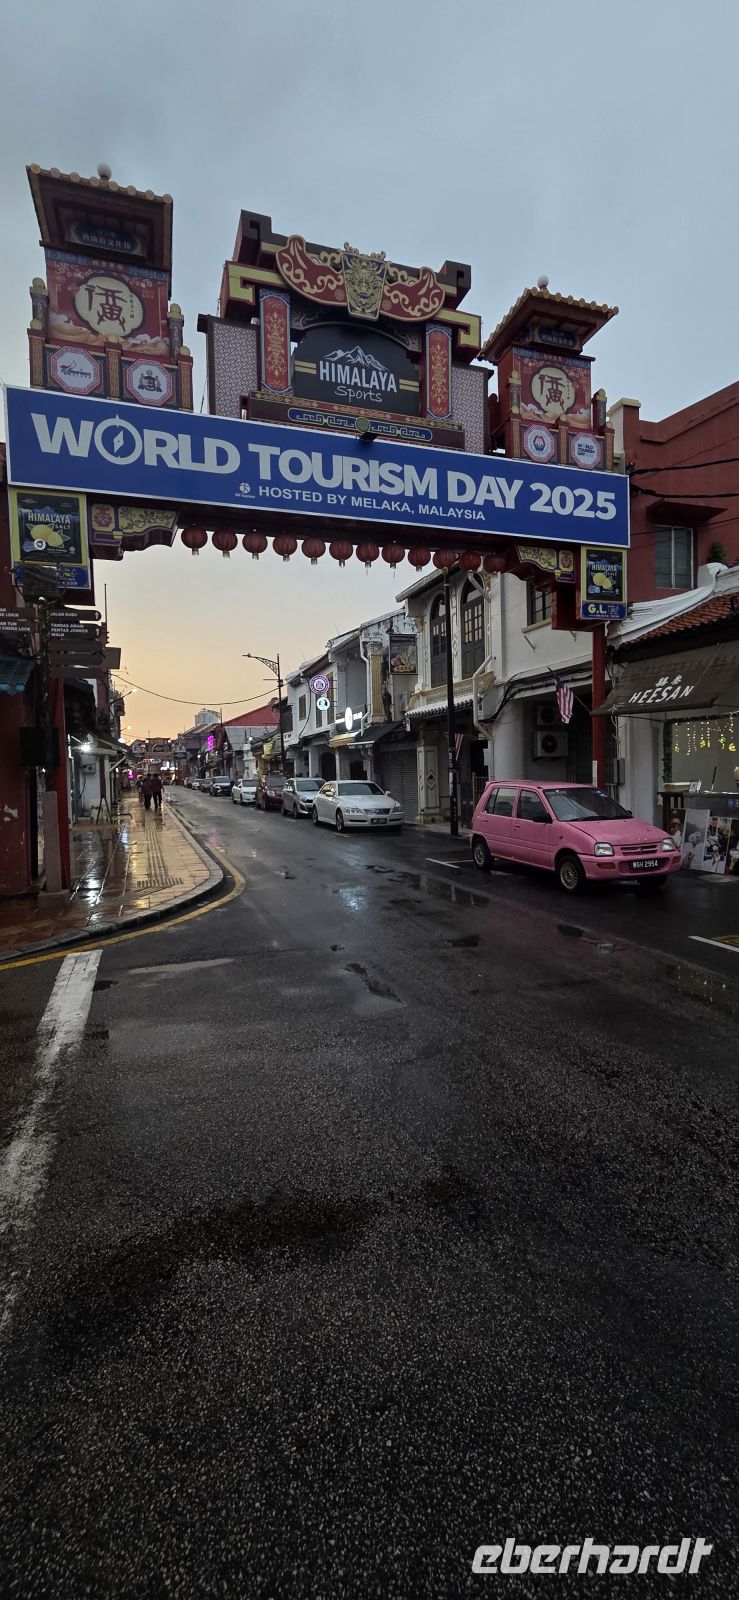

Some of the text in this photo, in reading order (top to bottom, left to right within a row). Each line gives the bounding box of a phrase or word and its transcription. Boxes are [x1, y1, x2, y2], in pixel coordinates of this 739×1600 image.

[319, 360, 398, 393] HIMALAYA
[334, 385, 383, 403] Sports
[30, 412, 617, 521] WORLD TOURISM DAY 2025
[258, 485, 486, 521] HOSTED BY MELAKA, MALAYSIA
[28, 512, 71, 525] HIMALAYA
[54, 523, 71, 531] SALT
[591, 564, 617, 572] HIMALAYA
[628, 685, 695, 704] HEESAN
